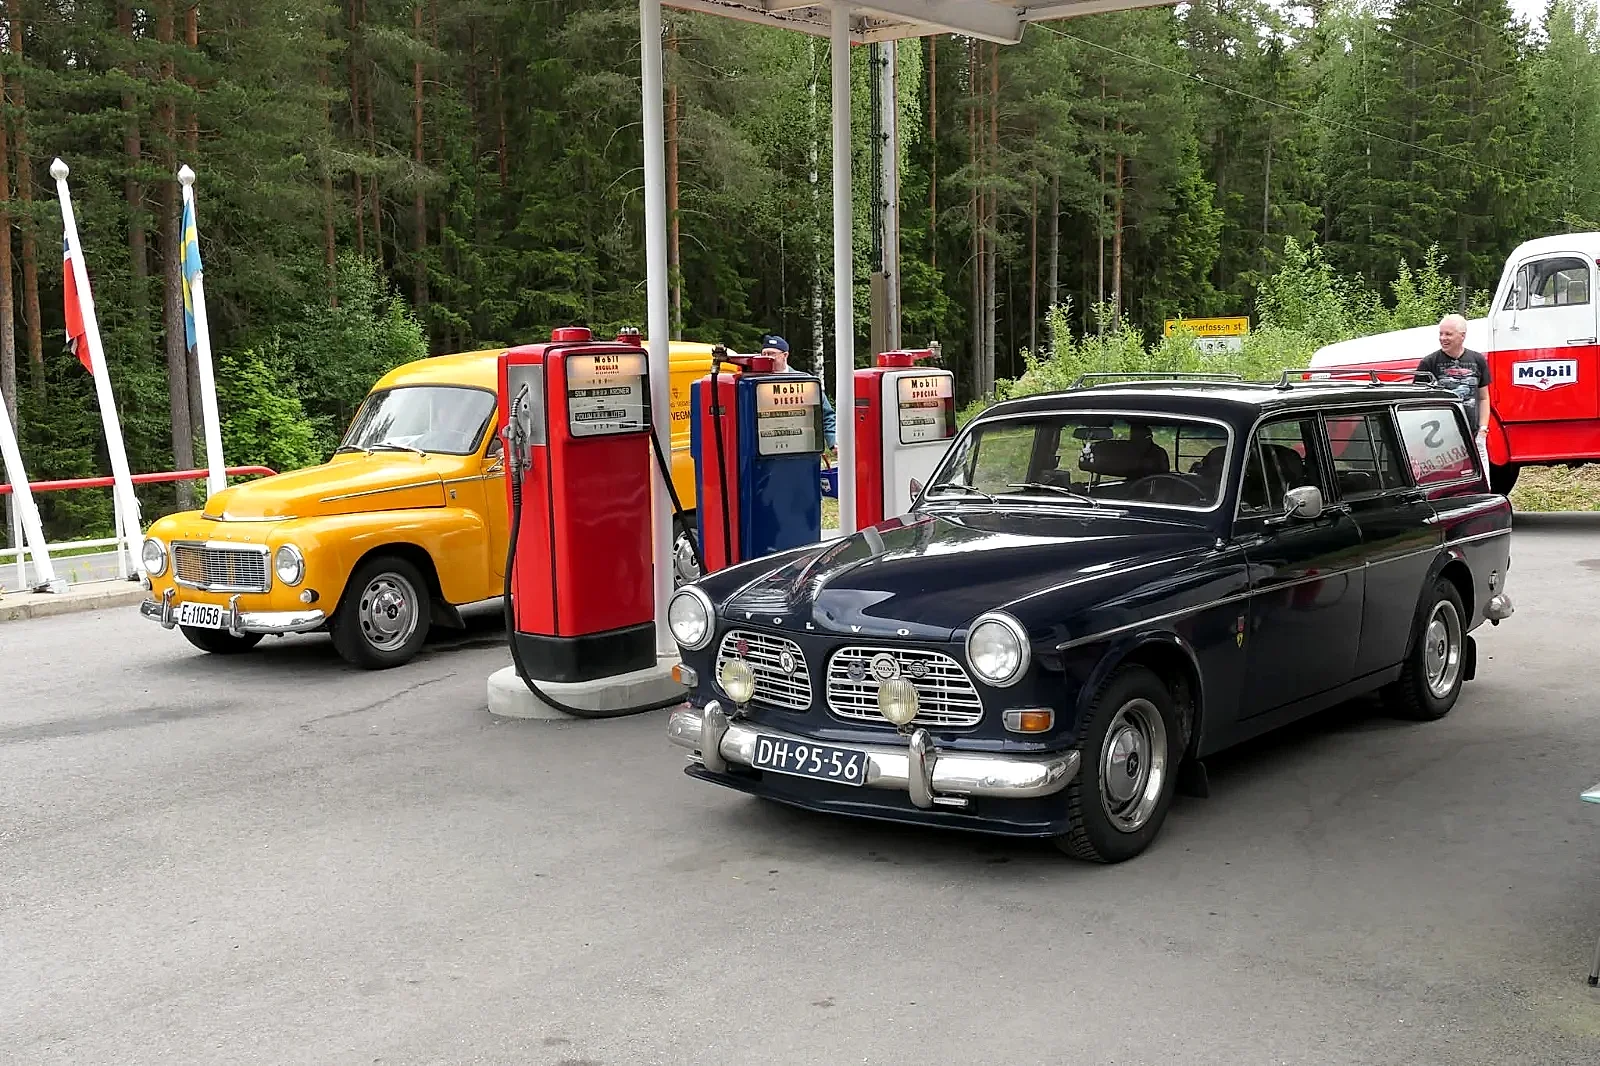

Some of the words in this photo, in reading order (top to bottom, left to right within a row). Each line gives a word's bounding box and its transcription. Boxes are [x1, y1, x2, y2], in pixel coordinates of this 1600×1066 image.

[594, 355, 619, 363] Mobil
[1518, 365, 1571, 378] Mobil
[772, 383, 804, 395] Mobil
[911, 378, 938, 389] Mobil
[912, 390, 938, 398] SPECIAL
[774, 396, 804, 405] DIESEL
[745, 611, 910, 636] VOLVO
[757, 739, 859, 780] DH-95-56
